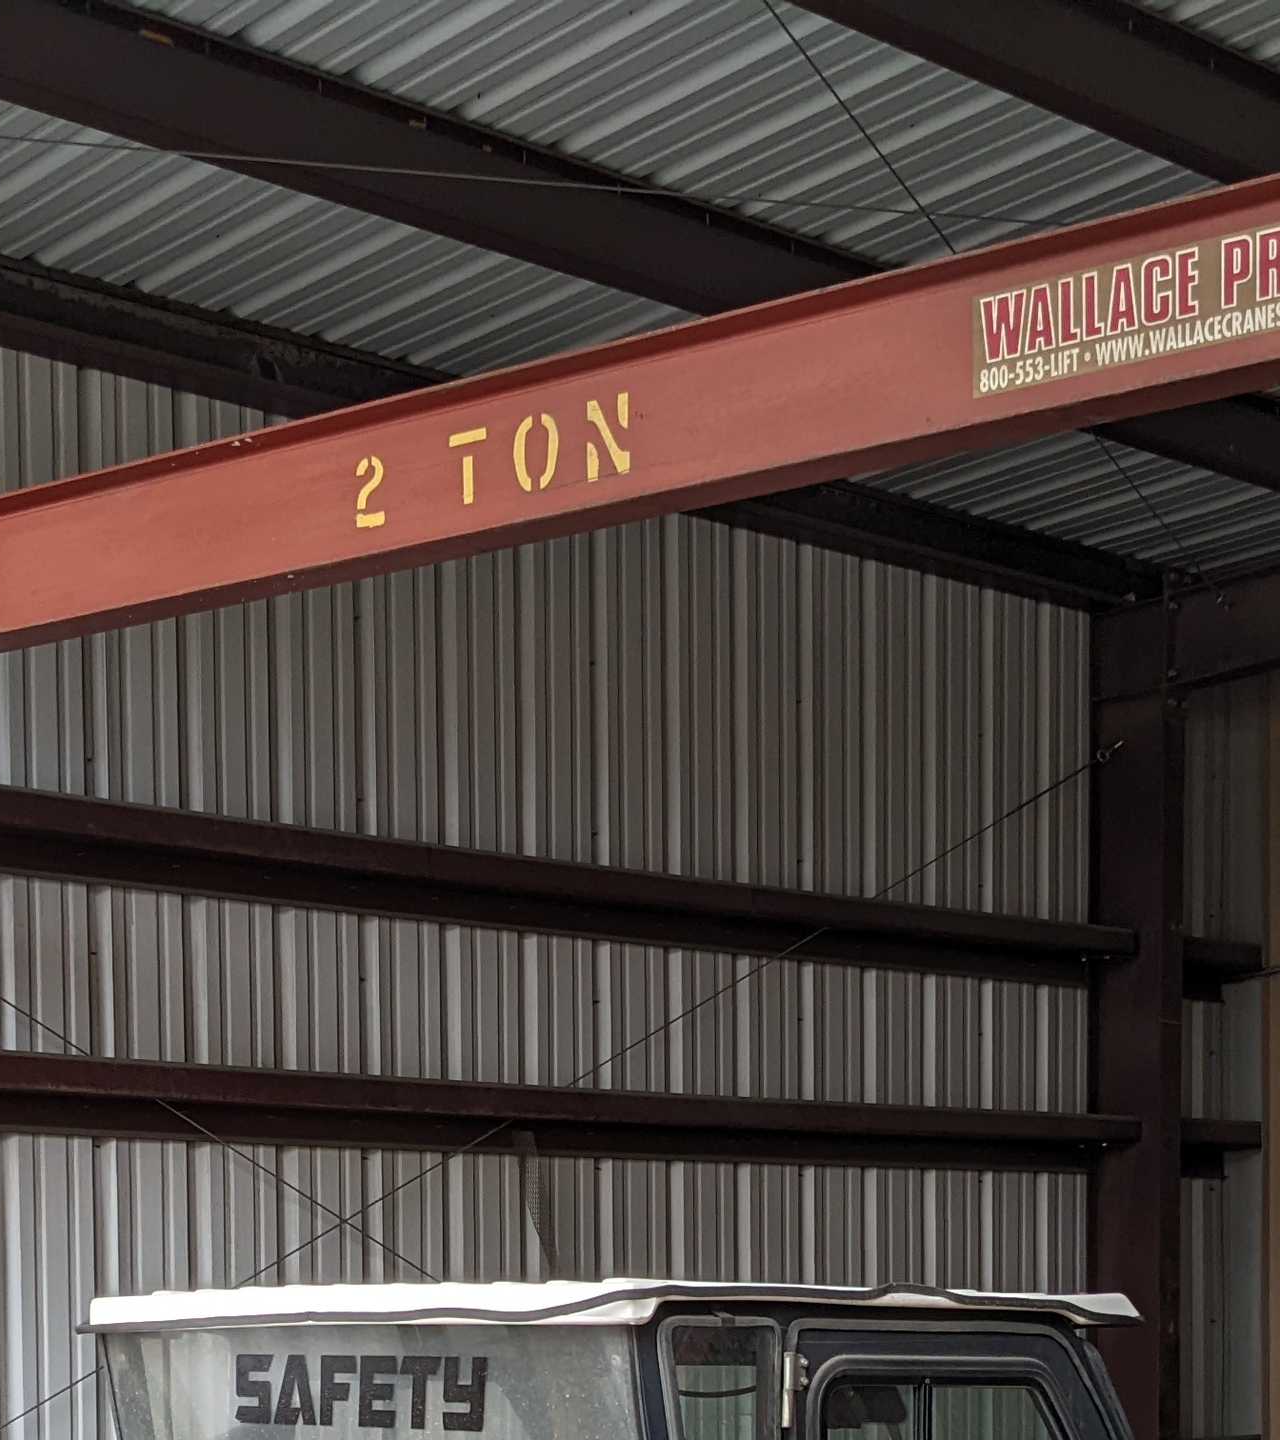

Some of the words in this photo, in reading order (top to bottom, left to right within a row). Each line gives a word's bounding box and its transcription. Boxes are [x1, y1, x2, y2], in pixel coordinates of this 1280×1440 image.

[980, 247, 1200, 363] WALLACE
[979, 348, 1080, 393] 800-553-LIFT
[355, 455, 386, 528] 2
[448, 391, 631, 505] TON
[234, 1354, 489, 1432] SAFETY
